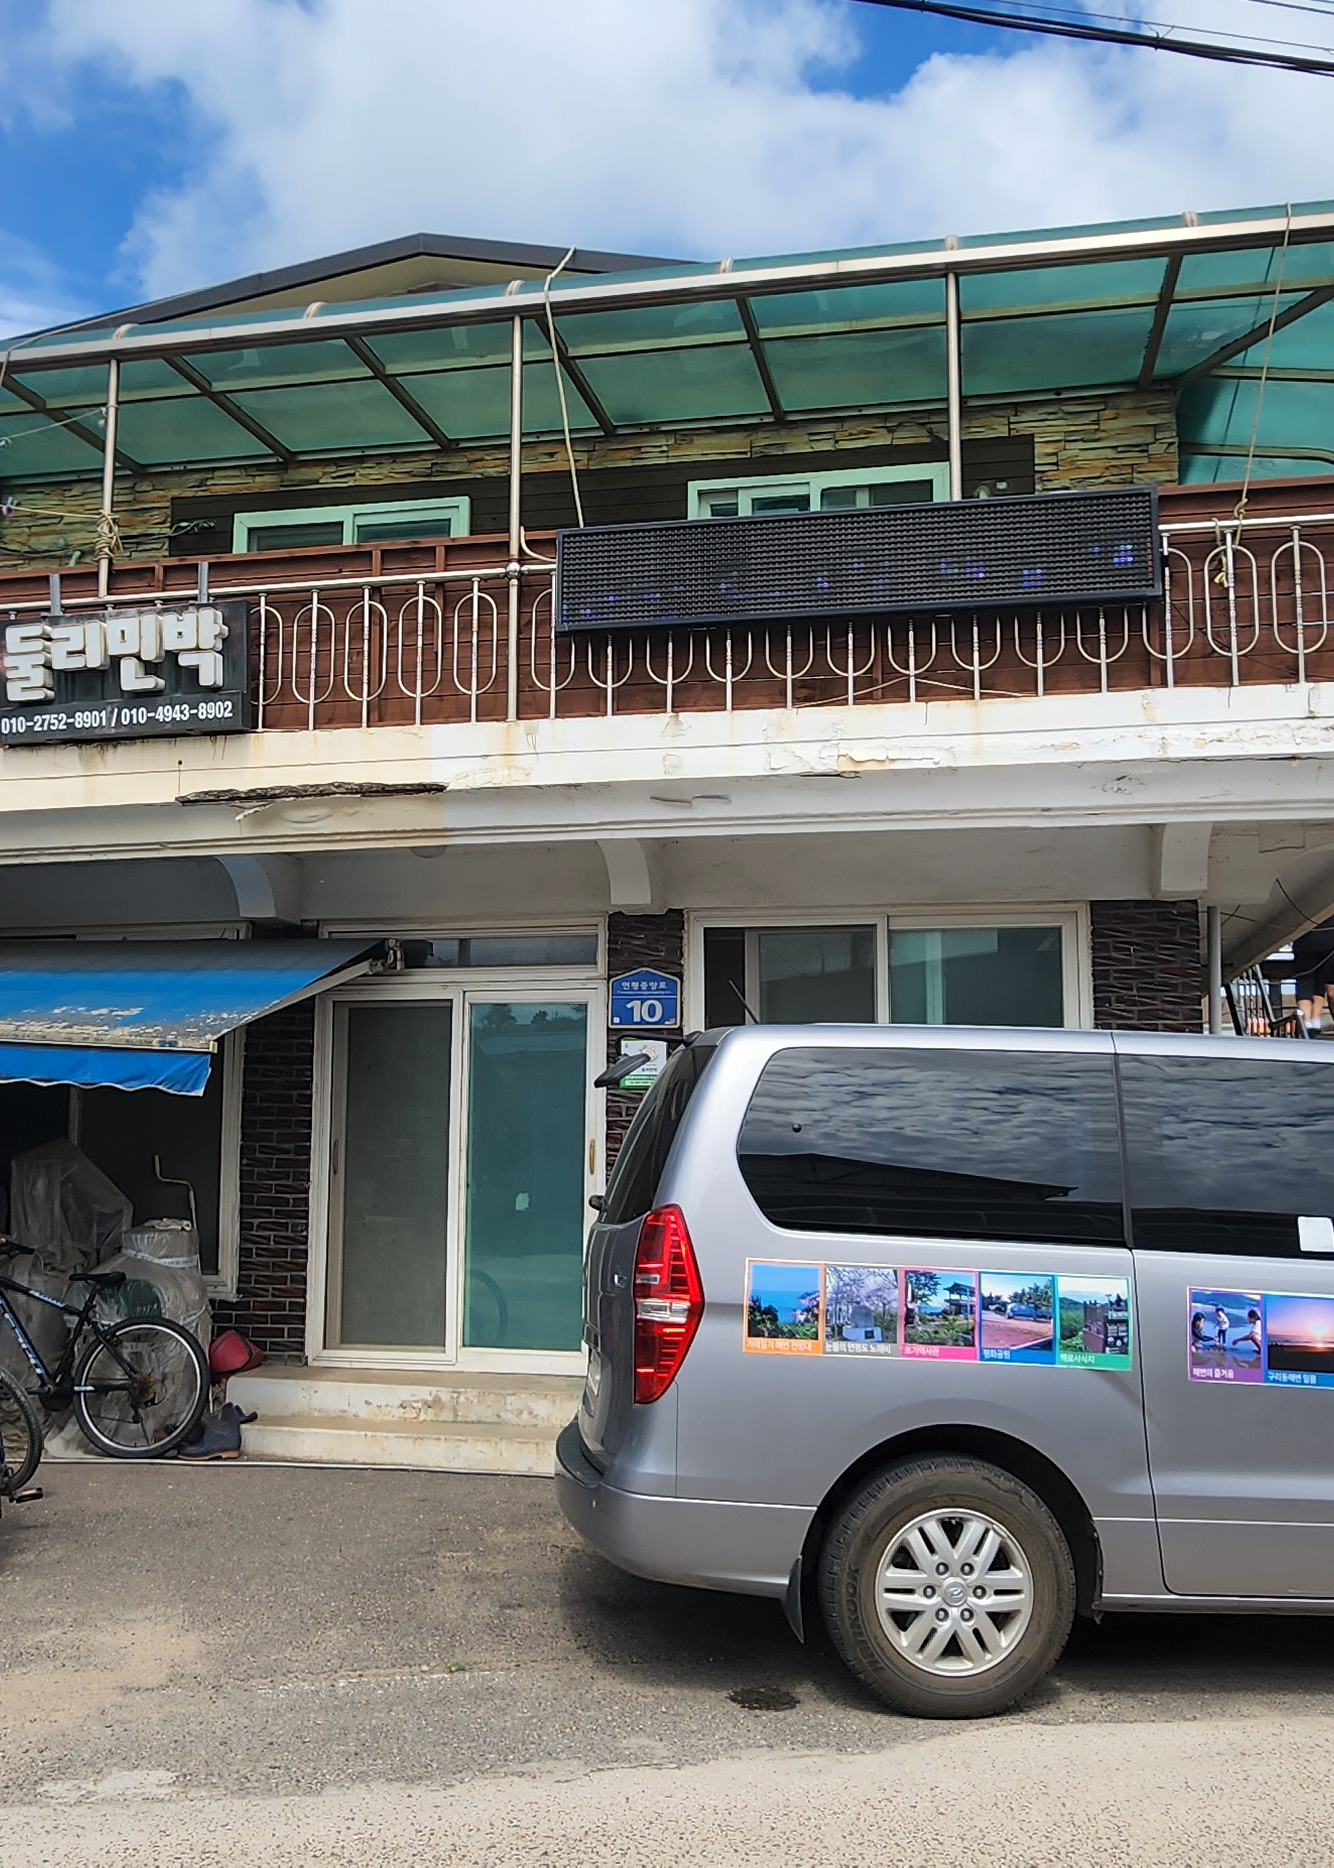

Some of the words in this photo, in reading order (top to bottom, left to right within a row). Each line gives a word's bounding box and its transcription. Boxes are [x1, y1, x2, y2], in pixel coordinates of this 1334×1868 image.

[3, 607, 228, 701] 둘리민박
[1, 709, 107, 734] 010-2752-8901
[121, 700, 233, 726] 010-4943-8902
[621, 981, 667, 990] 연평중앙로
[625, 999, 663, 1023] 10
